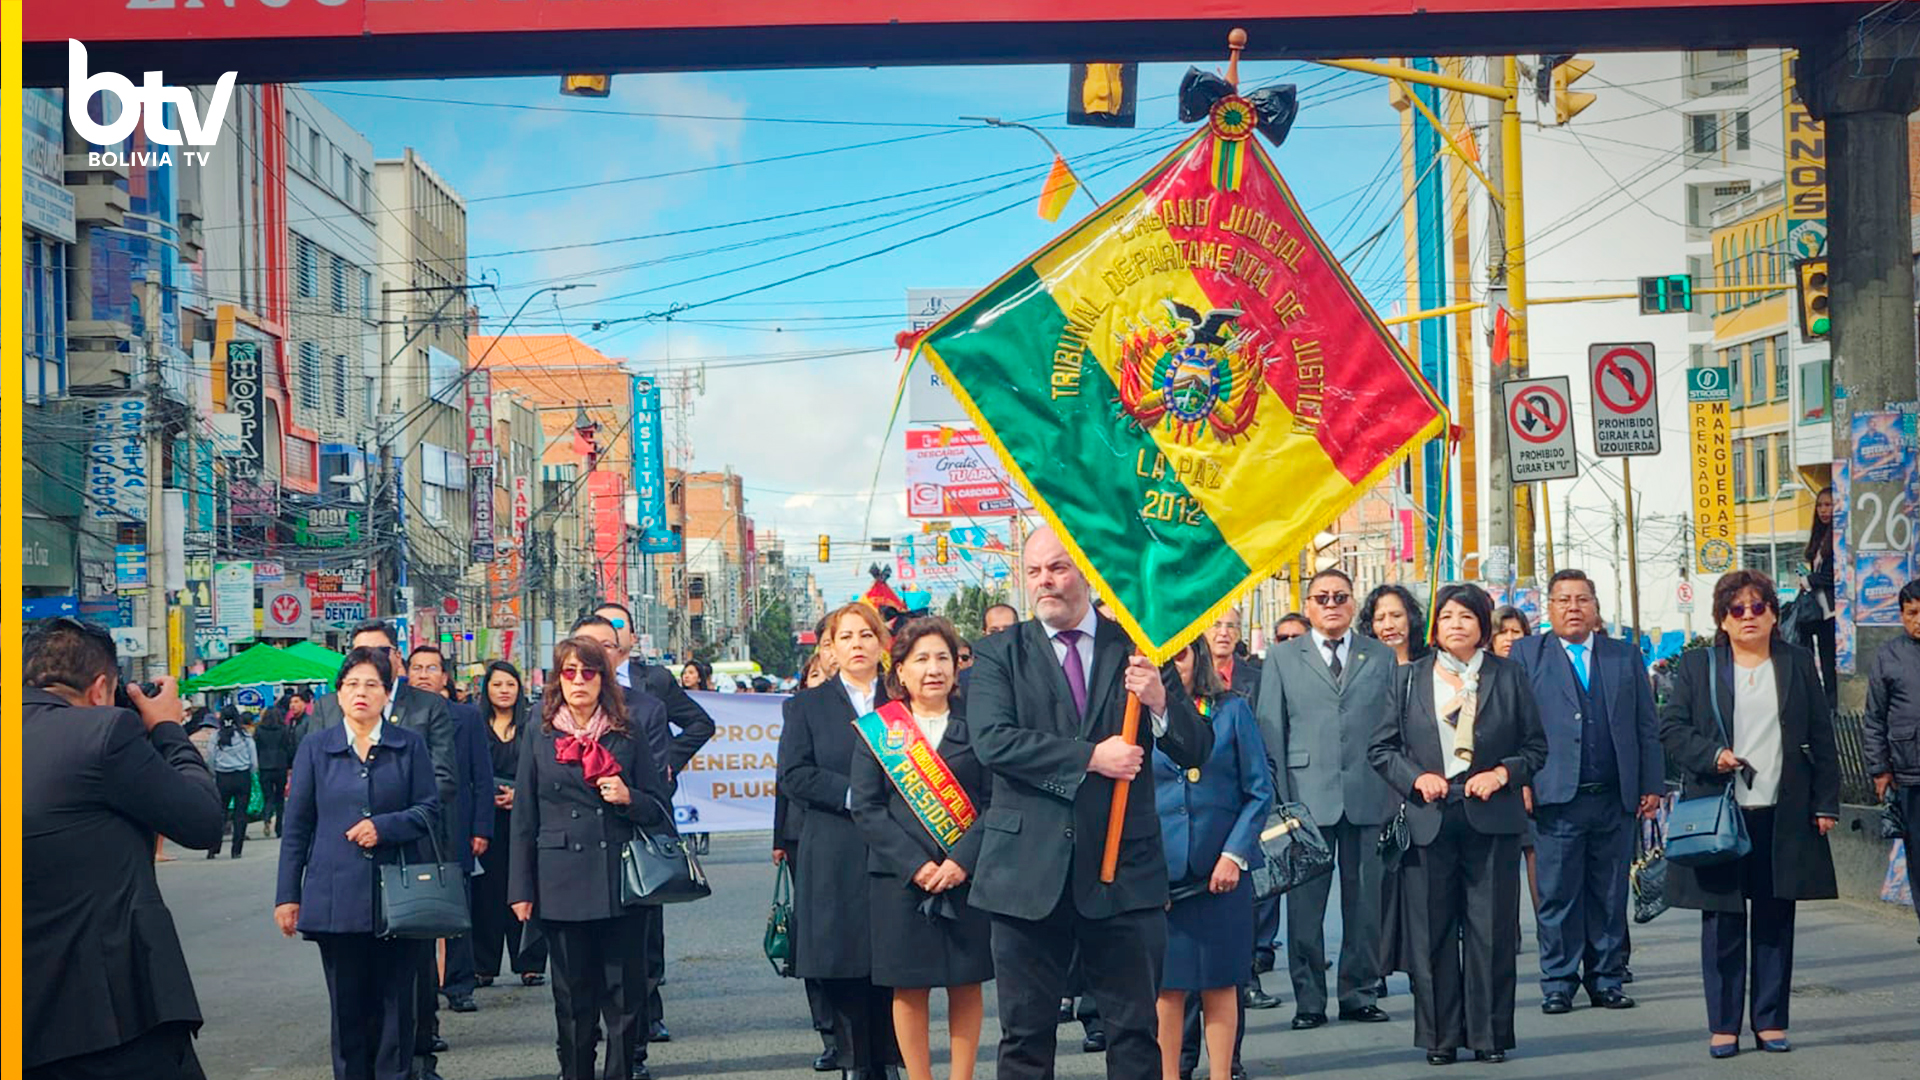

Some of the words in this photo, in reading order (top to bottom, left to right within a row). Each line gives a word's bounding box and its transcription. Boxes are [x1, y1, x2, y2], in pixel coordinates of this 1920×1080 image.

[1219, 203, 1309, 275] JUDICIAL
[1051, 296, 1110, 401] TRIBUNAL
[1101, 239, 1278, 298] DEPARTAMENTAL
[1273, 290, 1305, 330] DE
[1291, 336, 1325, 436] JUSTICIA
[231, 360, 259, 479] HOSTAL
[1598, 418, 1654, 429] PROHIBIDO
[1598, 430, 1631, 441] GIRAR
[1632, 429, 1640, 439] A
[1642, 428, 1655, 439] LA
[936, 456, 979, 471] Gratis
[1137, 447, 1165, 480] LA
[1175, 455, 1223, 490] PAZ
[1516, 462, 1542, 474] GIRAR
[1544, 461, 1556, 471] EN
[1519, 447, 1565, 461] PROHIBIDO
[1696, 403, 1711, 509] PRENSADO
[1712, 403, 1729, 538] MANGUERAS
[309, 509, 347, 526] BODY
[1142, 490, 1203, 525] 2012
[1857, 492, 1913, 551] 26
[1700, 513, 1711, 538] DE
[325, 607, 365, 620] DENTAL
[682, 753, 778, 771] ENERA
[908, 740, 947, 790] TRIBUNAL
[711, 781, 777, 799] PLUR
[893, 760, 963, 847] PRESIDEN
